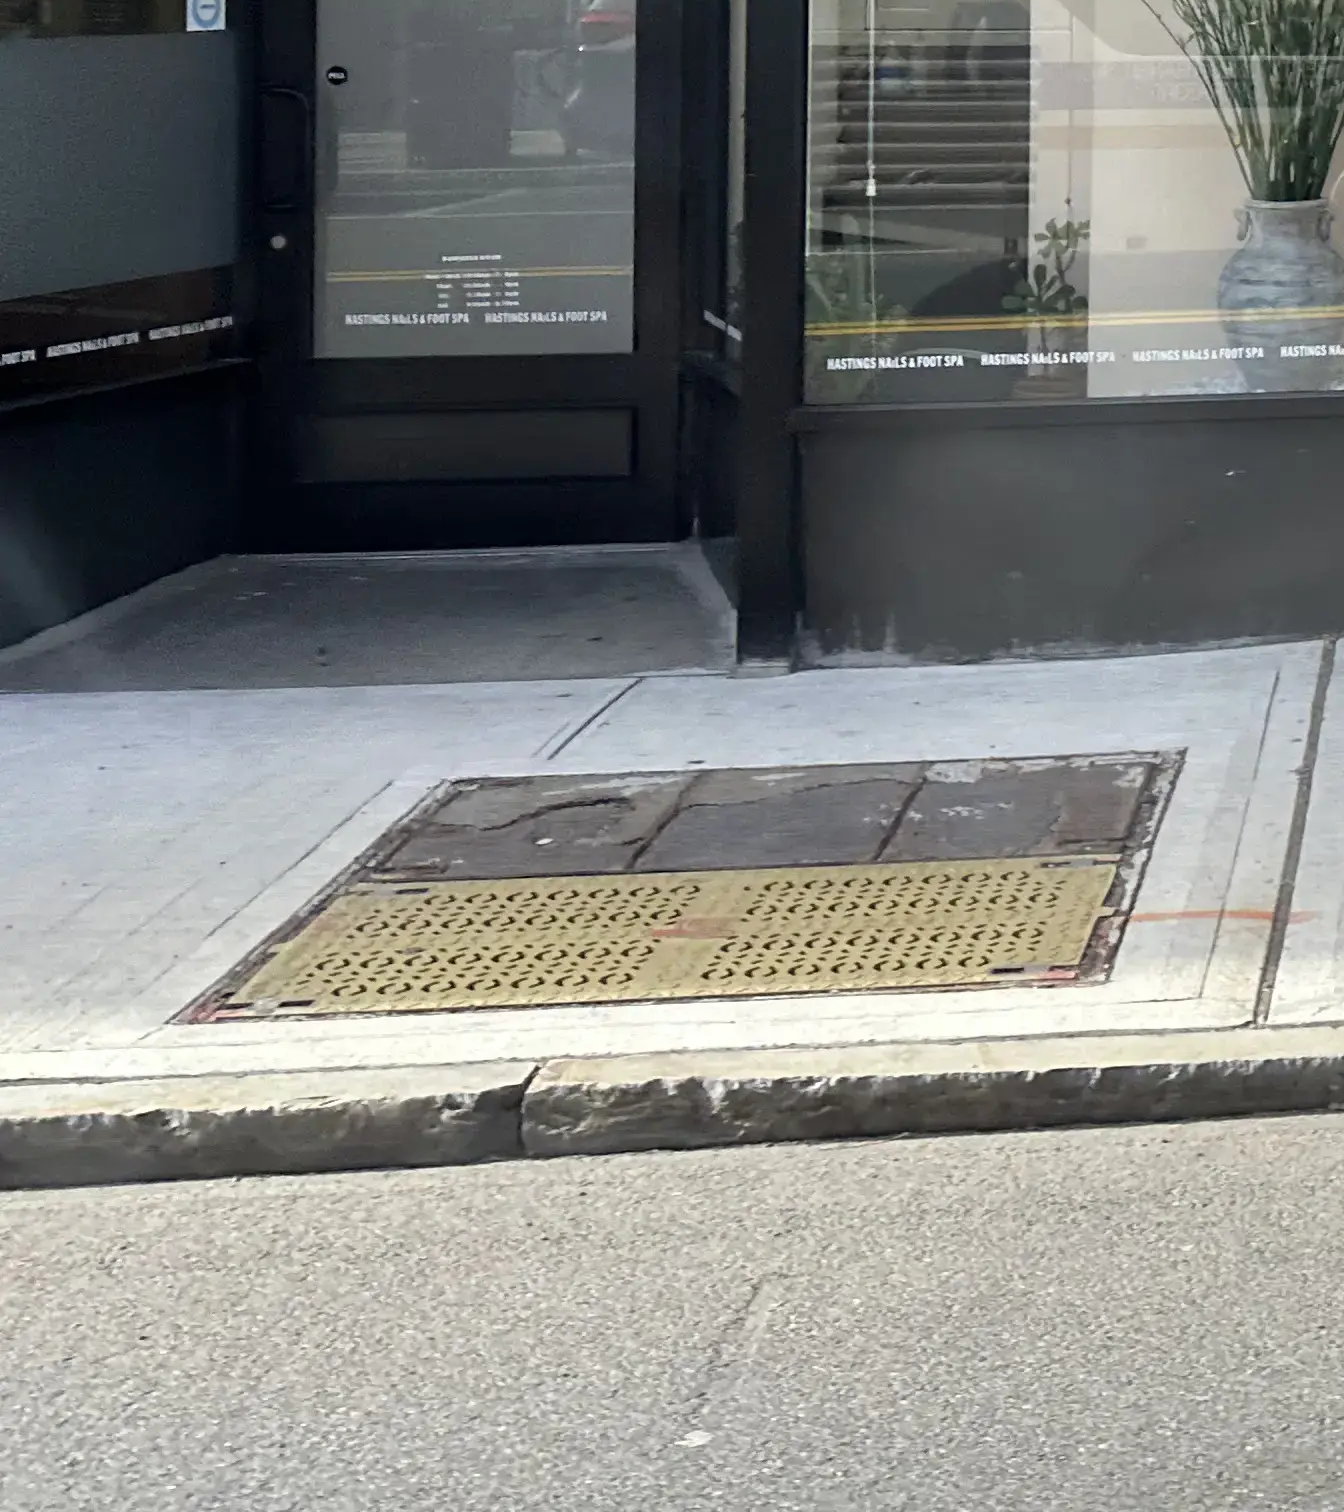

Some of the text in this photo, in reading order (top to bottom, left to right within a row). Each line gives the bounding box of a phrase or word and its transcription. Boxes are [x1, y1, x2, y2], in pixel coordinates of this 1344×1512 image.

[980, 353, 1030, 367] HASTINGS
[1069, 352, 1094, 364] FOOT
[1095, 351, 1115, 364] SPA
[1132, 349, 1181, 363] HASTINGS
[1219, 347, 1244, 360] FOOT
[1245, 347, 1264, 359] SPA
[1280, 345, 1327, 358] HASTINGS
[826, 357, 877, 370] HASTINGS
[917, 355, 942, 368] FOOT
[944, 355, 964, 367] SPA
